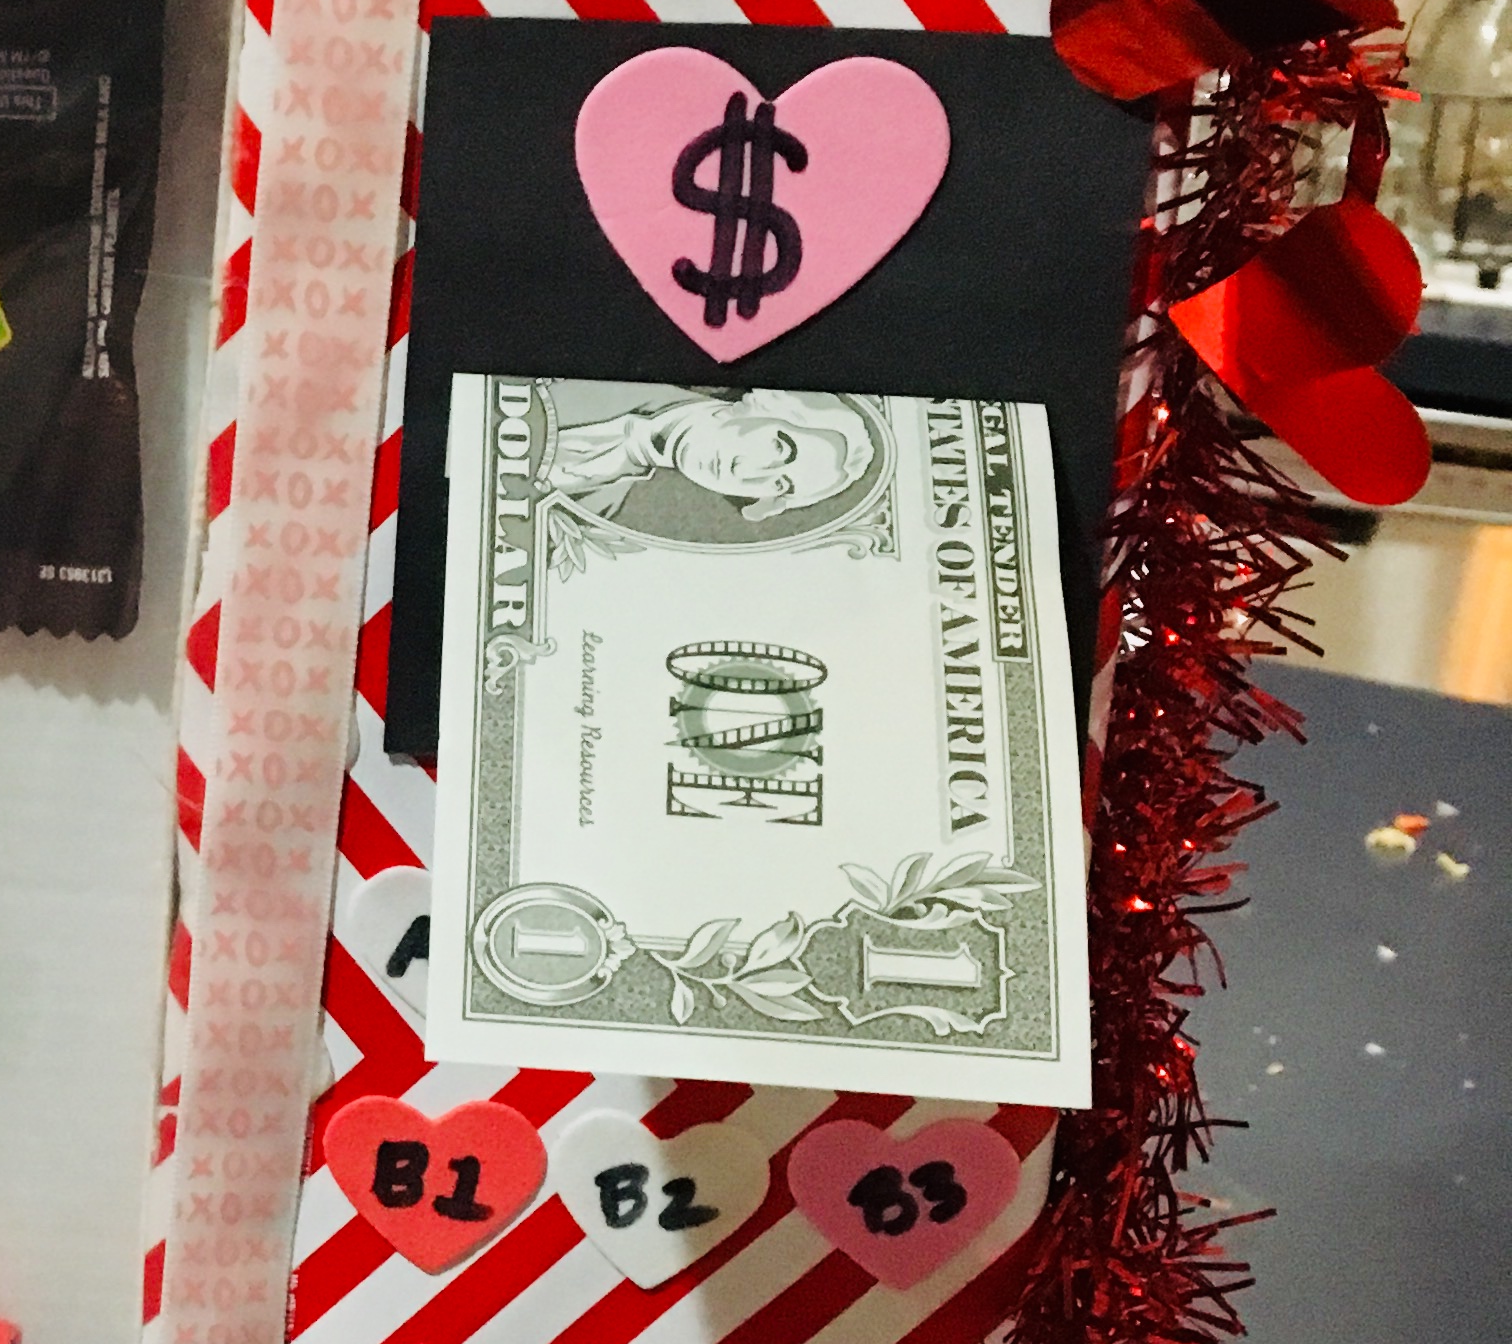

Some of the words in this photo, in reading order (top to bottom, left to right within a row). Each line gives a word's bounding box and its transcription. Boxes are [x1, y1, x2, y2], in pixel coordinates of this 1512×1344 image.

[670, 89, 810, 328] $
[492, 381, 533, 630] DOLLAR
[927, 398, 972, 529] TATES
[934, 539, 979, 601] OF
[989, 489, 1024, 655] TENDER
[579, 628, 604, 720] Learning
[939, 602, 991, 836] AMERICA
[578, 723, 604, 829] Resources
[371, 1139, 495, 1223] B1
[594, 1161, 720, 1232] B2
[846, 1159, 970, 1236] B3
